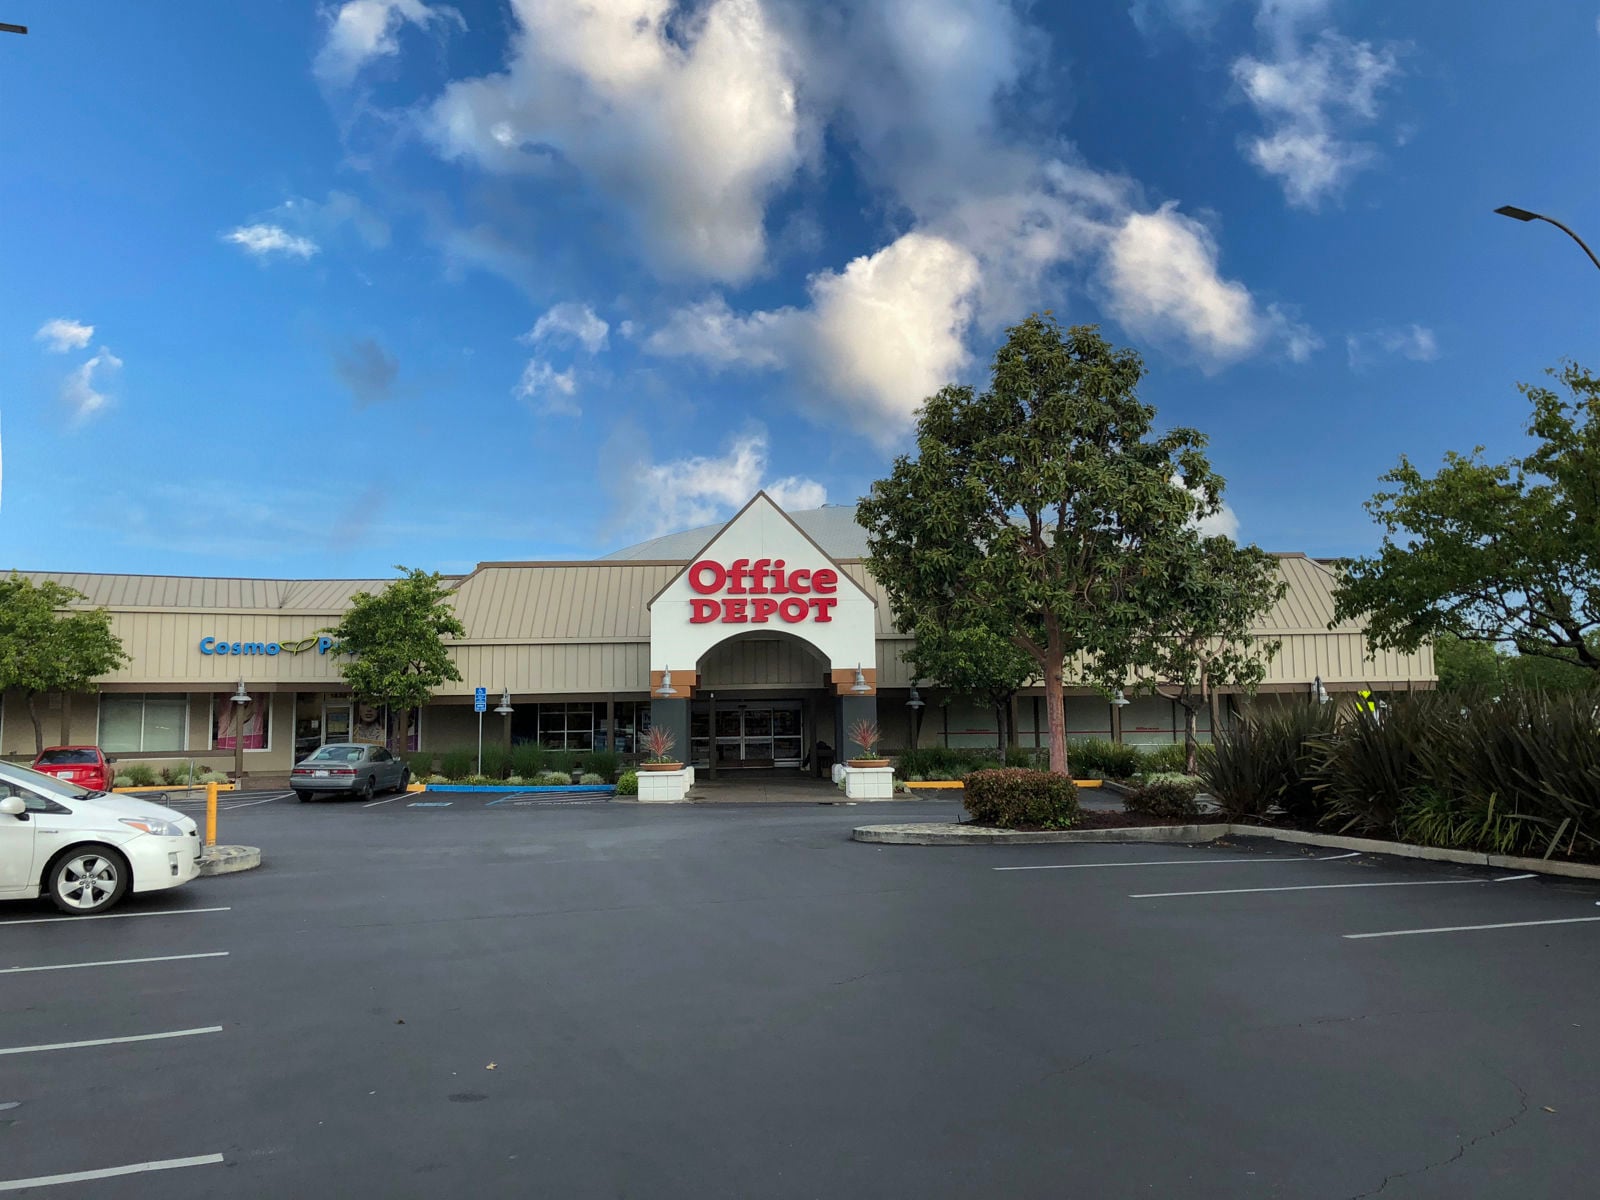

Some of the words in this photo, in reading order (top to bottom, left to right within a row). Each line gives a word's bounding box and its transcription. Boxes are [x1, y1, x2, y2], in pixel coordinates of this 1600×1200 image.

[688, 558, 838, 595] Office
[689, 597, 838, 624] DEPOT
[199, 636, 281, 656] Cosmo
